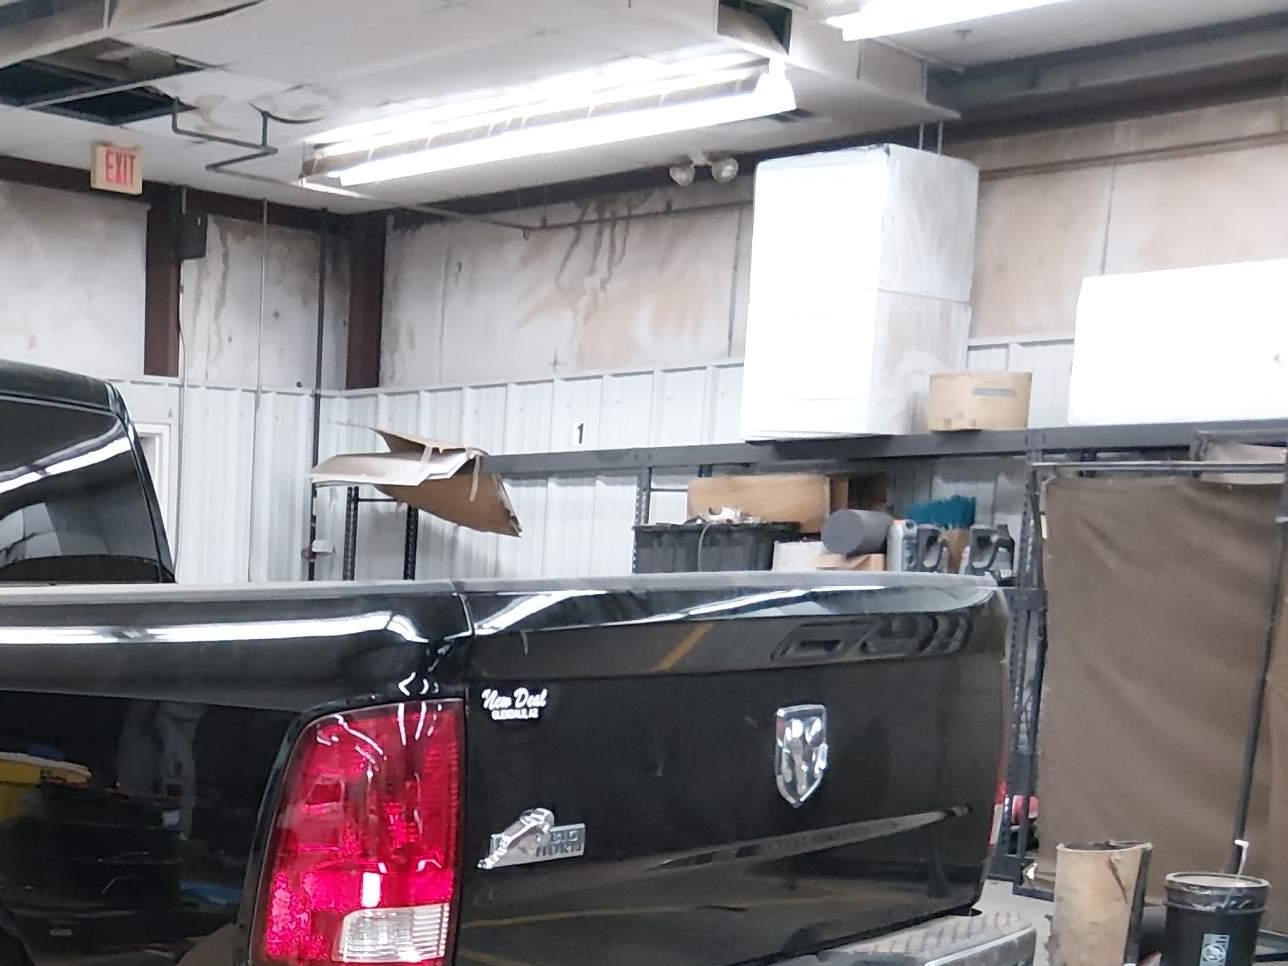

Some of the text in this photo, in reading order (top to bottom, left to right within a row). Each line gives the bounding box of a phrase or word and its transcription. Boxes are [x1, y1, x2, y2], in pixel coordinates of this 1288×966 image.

[104, 149, 137, 187] EXIT
[577, 422, 584, 445] 1
[513, 687, 548, 709] Deal
